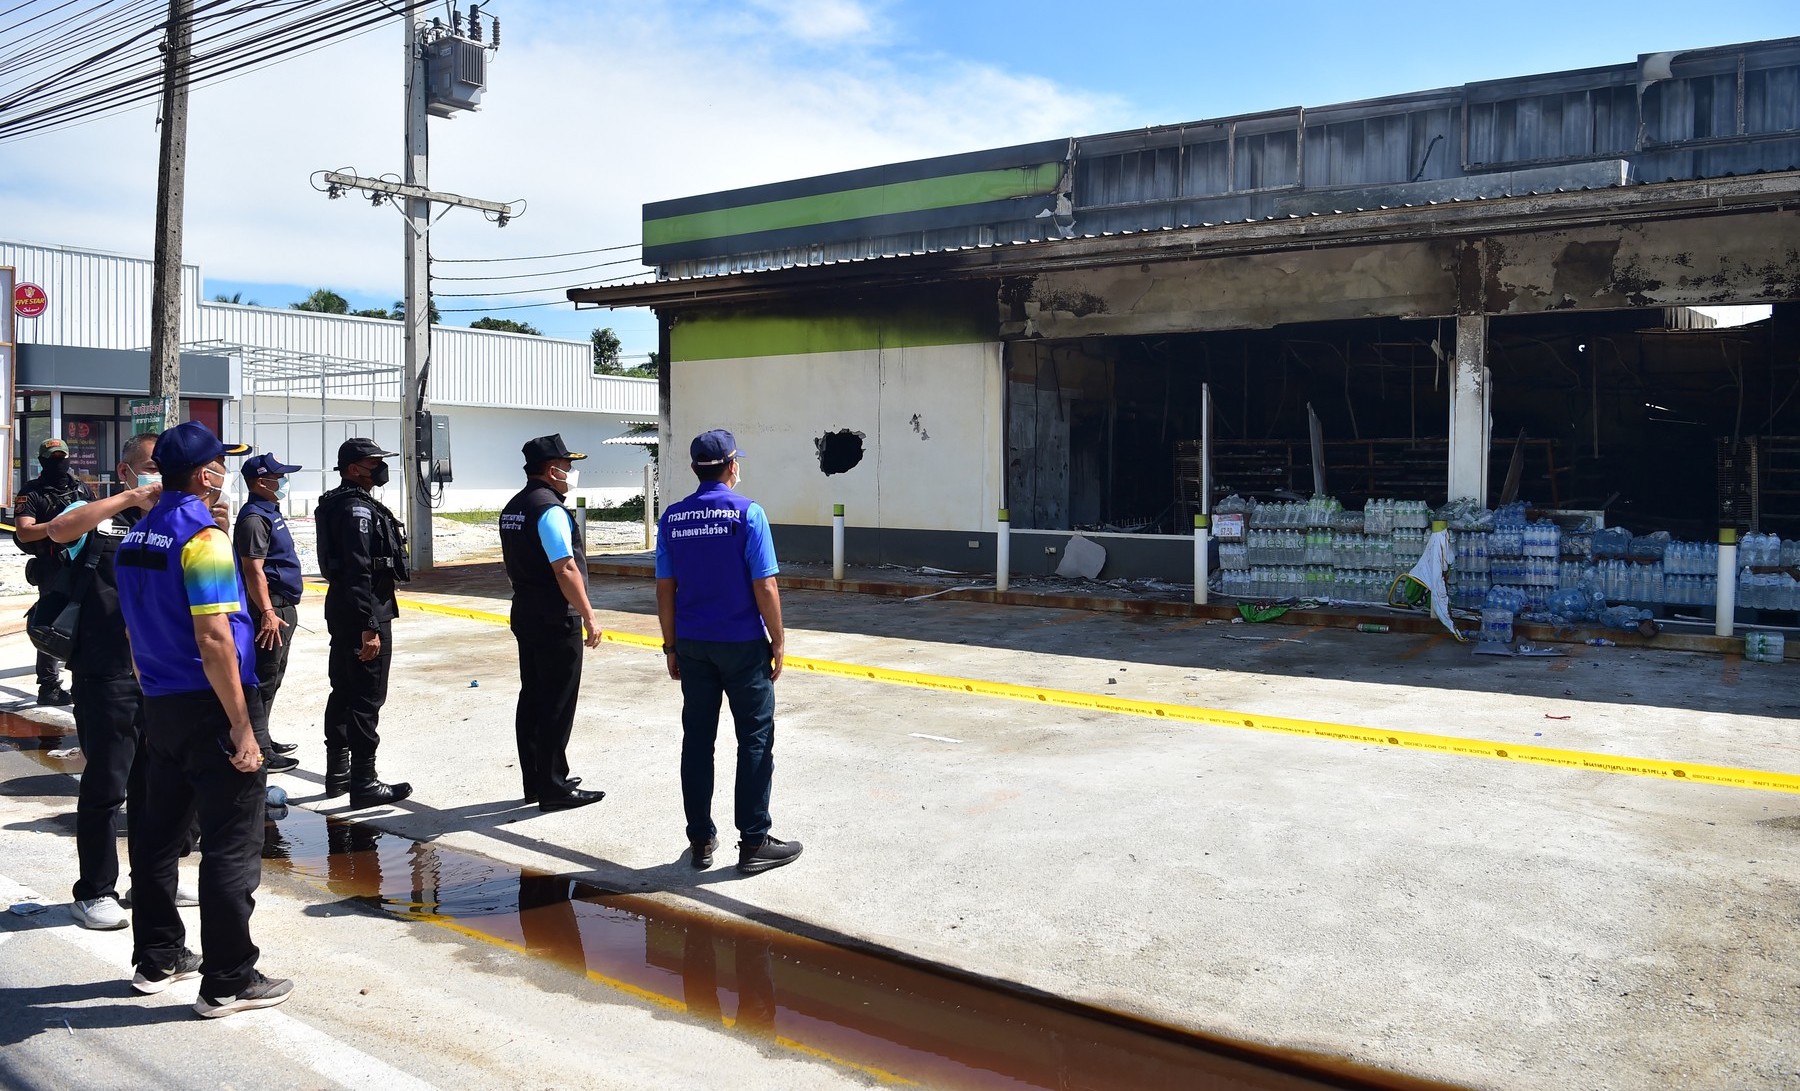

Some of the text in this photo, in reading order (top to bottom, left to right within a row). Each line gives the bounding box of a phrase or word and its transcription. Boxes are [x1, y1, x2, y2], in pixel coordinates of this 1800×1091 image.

[667, 507, 740, 523] กรมการปกครอง
[671, 523, 728, 539] อำเภอเจาะไอร้อง
